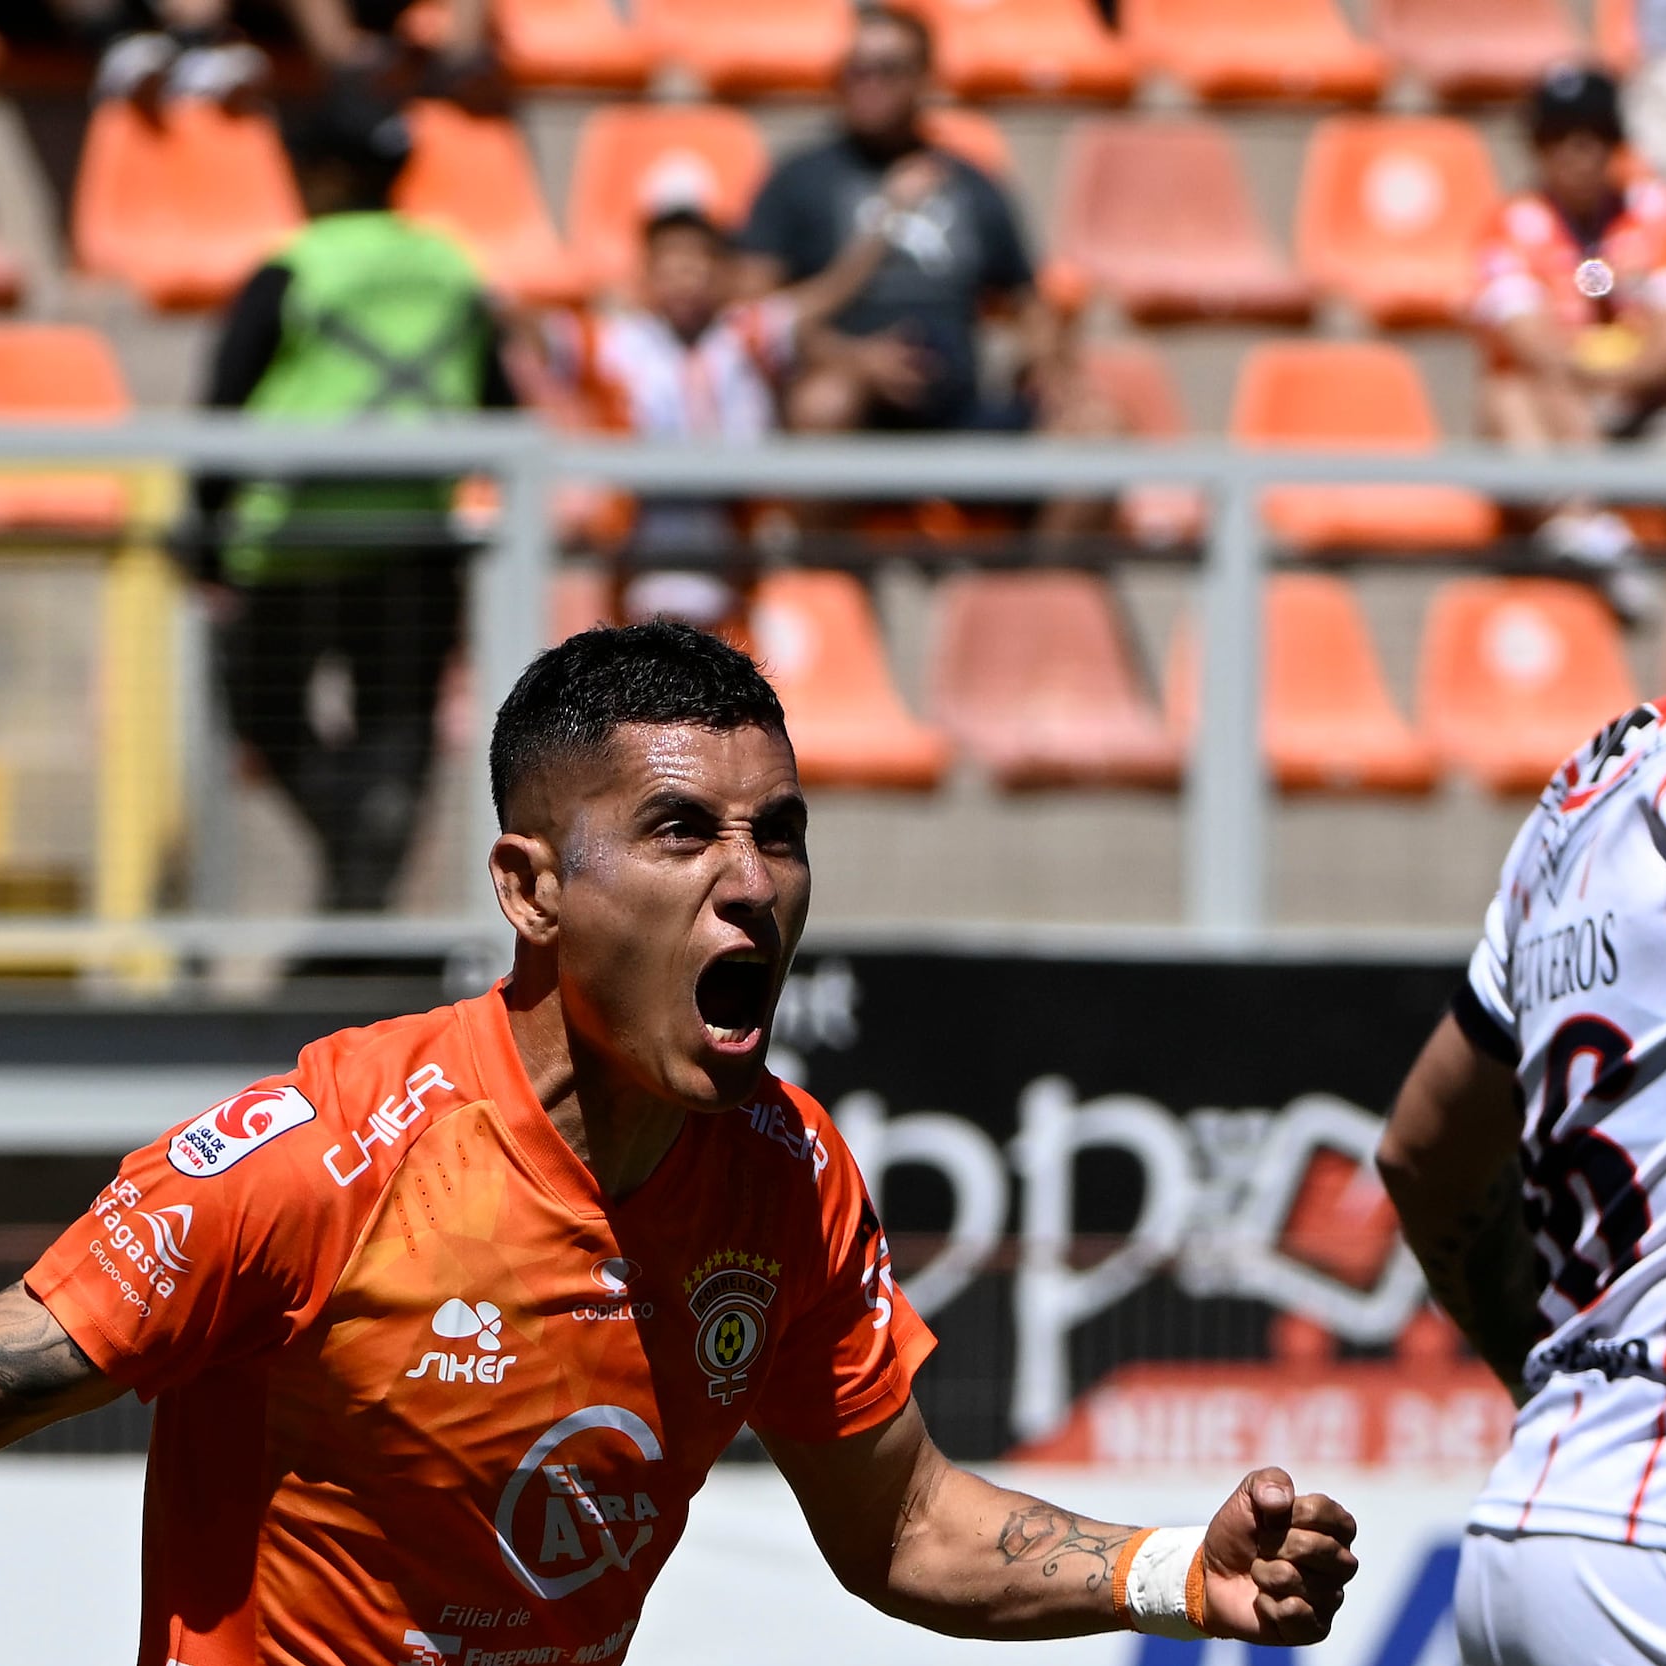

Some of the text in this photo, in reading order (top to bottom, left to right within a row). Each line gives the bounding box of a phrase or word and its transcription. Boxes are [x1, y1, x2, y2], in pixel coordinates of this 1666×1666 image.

[571, 1301, 654, 1322] CODELCO
[439, 1604, 531, 1628] Filial de
